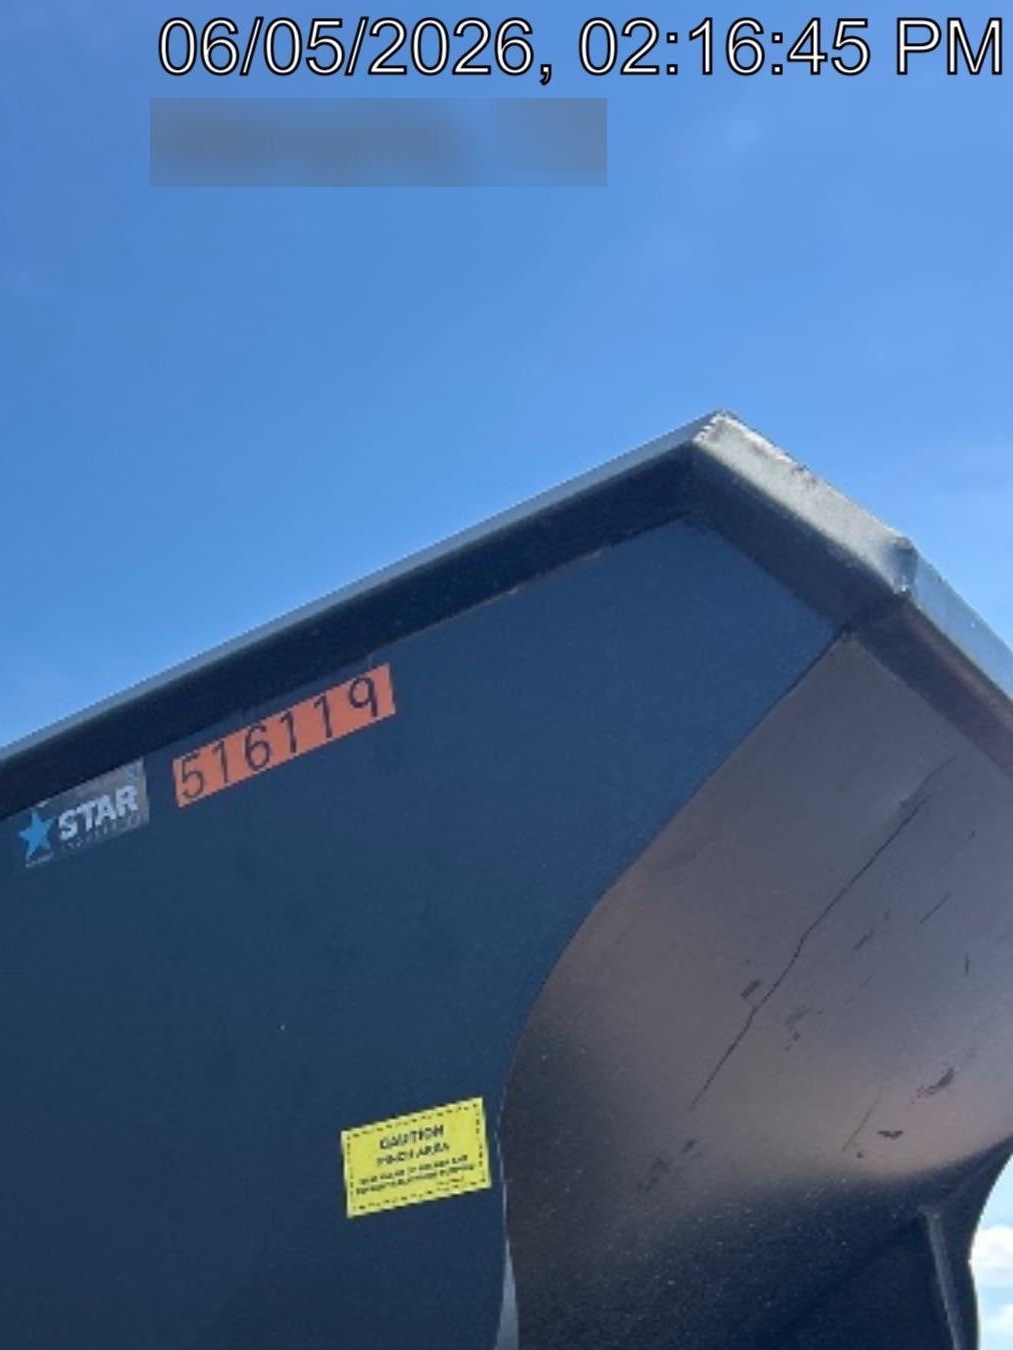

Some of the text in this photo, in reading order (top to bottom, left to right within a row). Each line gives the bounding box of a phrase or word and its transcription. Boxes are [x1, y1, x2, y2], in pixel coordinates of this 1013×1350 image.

[181, 677, 378, 799] 516119
[58, 785, 139, 840] STAR
[379, 1124, 444, 1150] CAUTION
